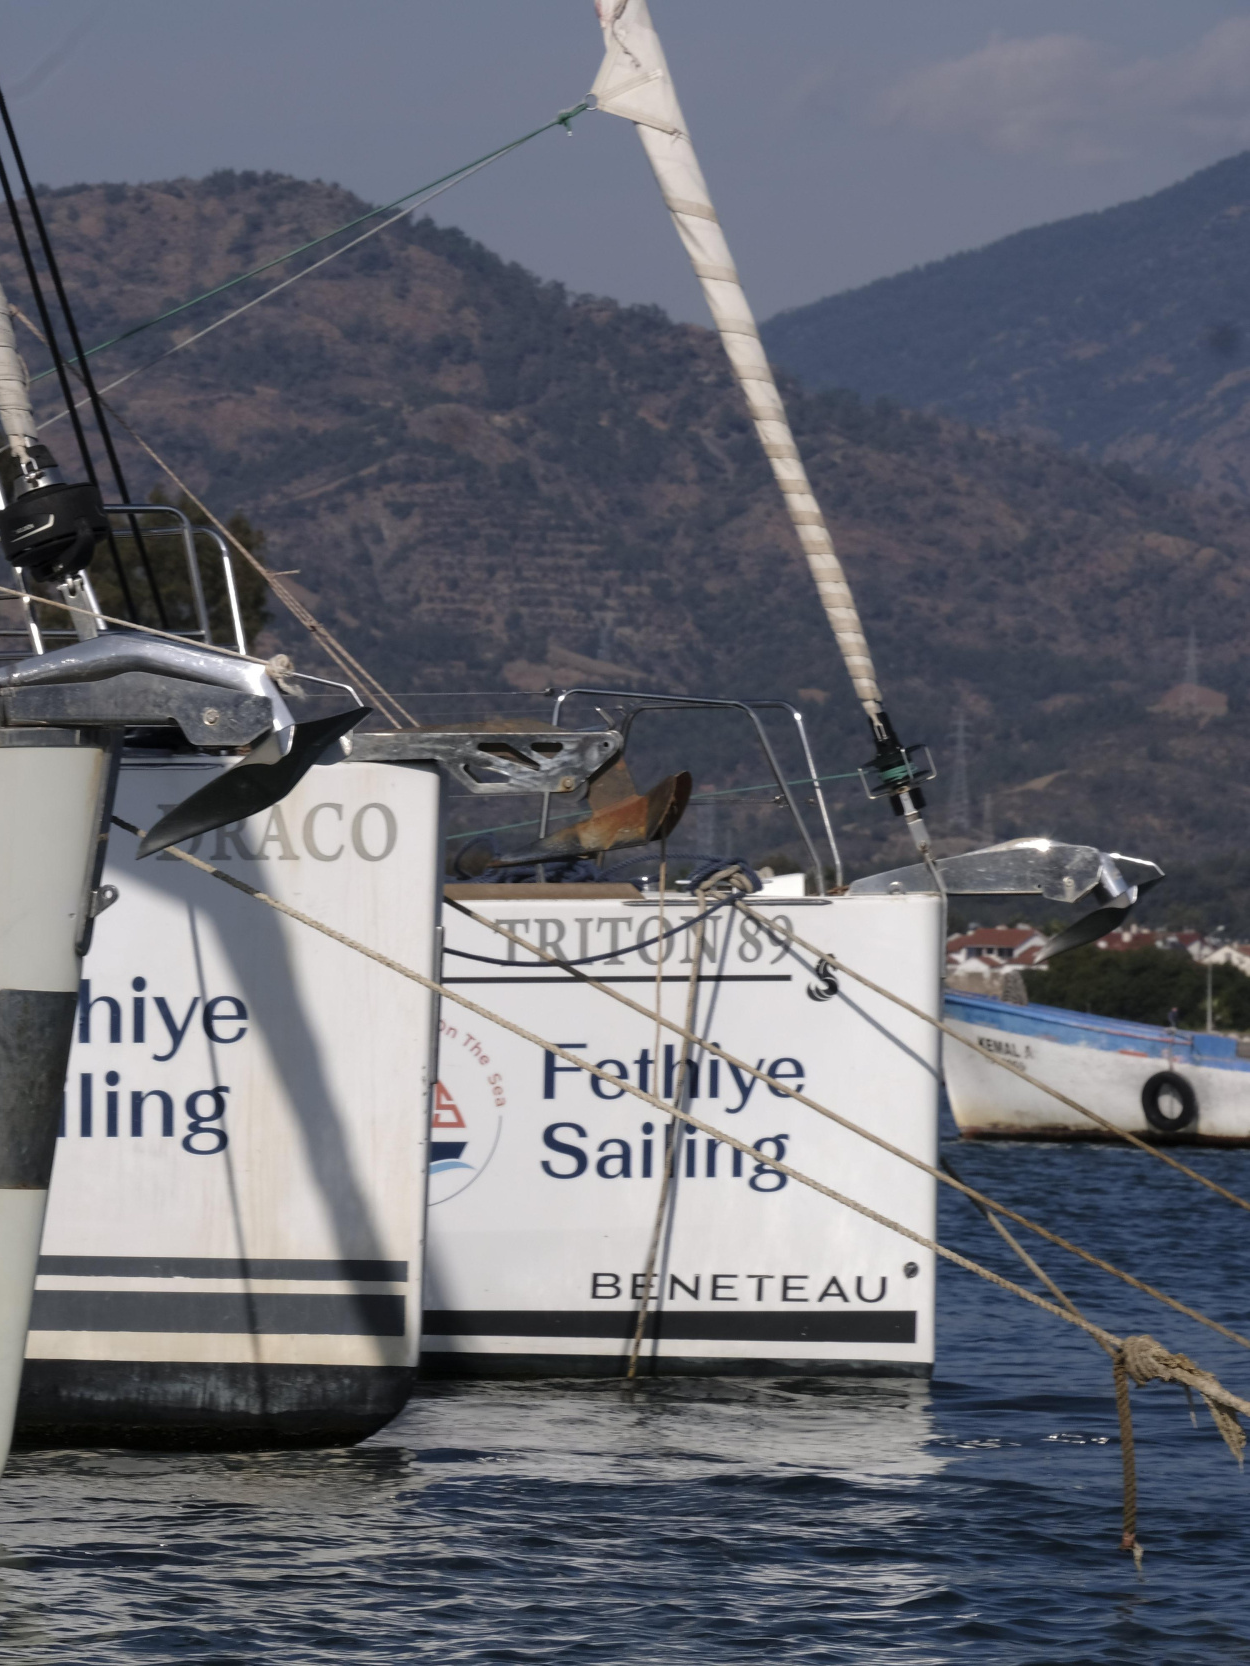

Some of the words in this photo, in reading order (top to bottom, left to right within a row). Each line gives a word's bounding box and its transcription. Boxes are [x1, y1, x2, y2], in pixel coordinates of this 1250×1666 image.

[494, 915, 722, 967] TRITON
[738, 914, 794, 965] 89
[78, 976, 249, 1062] hiye
[462, 1033, 491, 1066] The
[487, 1073, 507, 1107] Sea
[543, 1041, 806, 1114] Fethiye
[56, 1070, 230, 1156] ling
[541, 1121, 790, 1193] Sailing
[591, 1272, 888, 1304] BENETEAU
